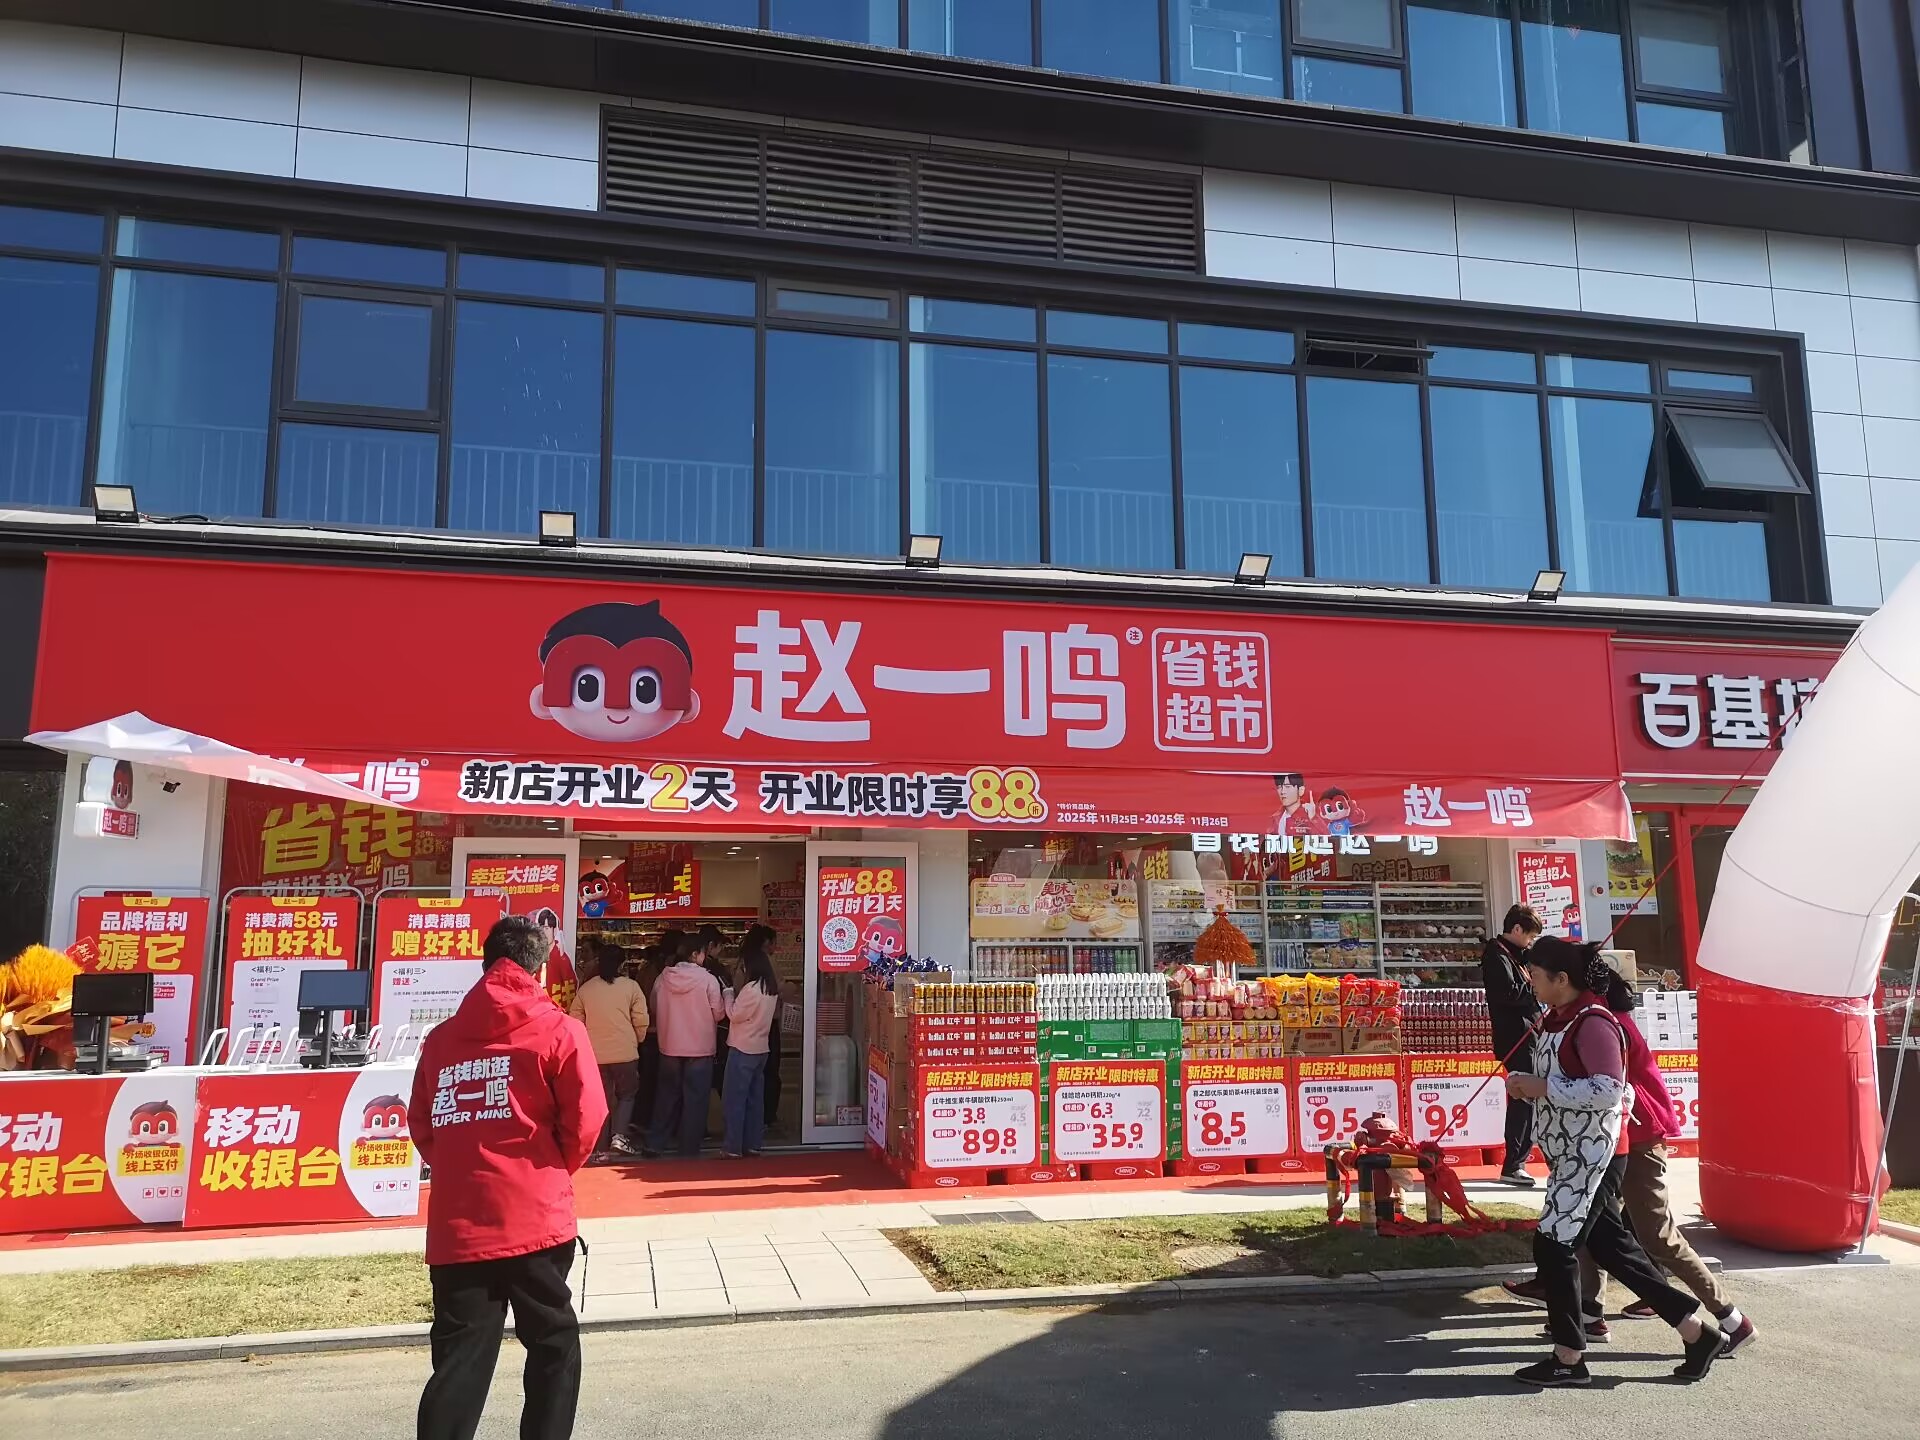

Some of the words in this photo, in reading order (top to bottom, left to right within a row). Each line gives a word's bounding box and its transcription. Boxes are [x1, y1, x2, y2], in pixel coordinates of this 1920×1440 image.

[1161, 638, 1260, 690] 省钱
[722, 609, 1127, 749] 赵一鸣
[1163, 695, 1263, 743] 超市
[462, 762, 734, 810] 新店开业2天
[1403, 784, 1531, 827] 赵一鸣
[1352, 858, 1410, 882] 8号会员日
[1523, 855, 1547, 867] Hey!
[471, 864, 558, 886] 幸运大抽奖
[1523, 865, 1572, 884] 这里招人
[629, 894, 692, 914] 就逛赵一鸣
[827, 893, 902, 916] 限时2天
[100, 911, 188, 931] 品牌福利
[245, 911, 338, 929] 消费满58元
[408, 914, 471, 929] 消费满额
[95, 932, 185, 971] 薅它
[241, 928, 343, 957] 抽好礼
[390, 929, 484, 957] 赠好礼
[947, 1017, 960, 1025] 红牛
[1008, 1015, 1021, 1024] 红牛
[946, 1032, 960, 1041] 红牛
[1007, 1031, 1021, 1040] 红牛
[945, 1048, 960, 1056] 红牛
[1006, 1046, 1020, 1055] 红牛
[437, 1056, 511, 1088] 省钱就逛
[431, 1078, 508, 1117] 赵一鸣
[203, 1104, 300, 1148] 移动
[431, 1111, 471, 1128] SUPER
[475, 1107, 512, 1121] MING
[125, 1159, 178, 1173] 线上支付
[200, 1146, 341, 1191] 收银台
[357, 1152, 408, 1166] 线上支付
